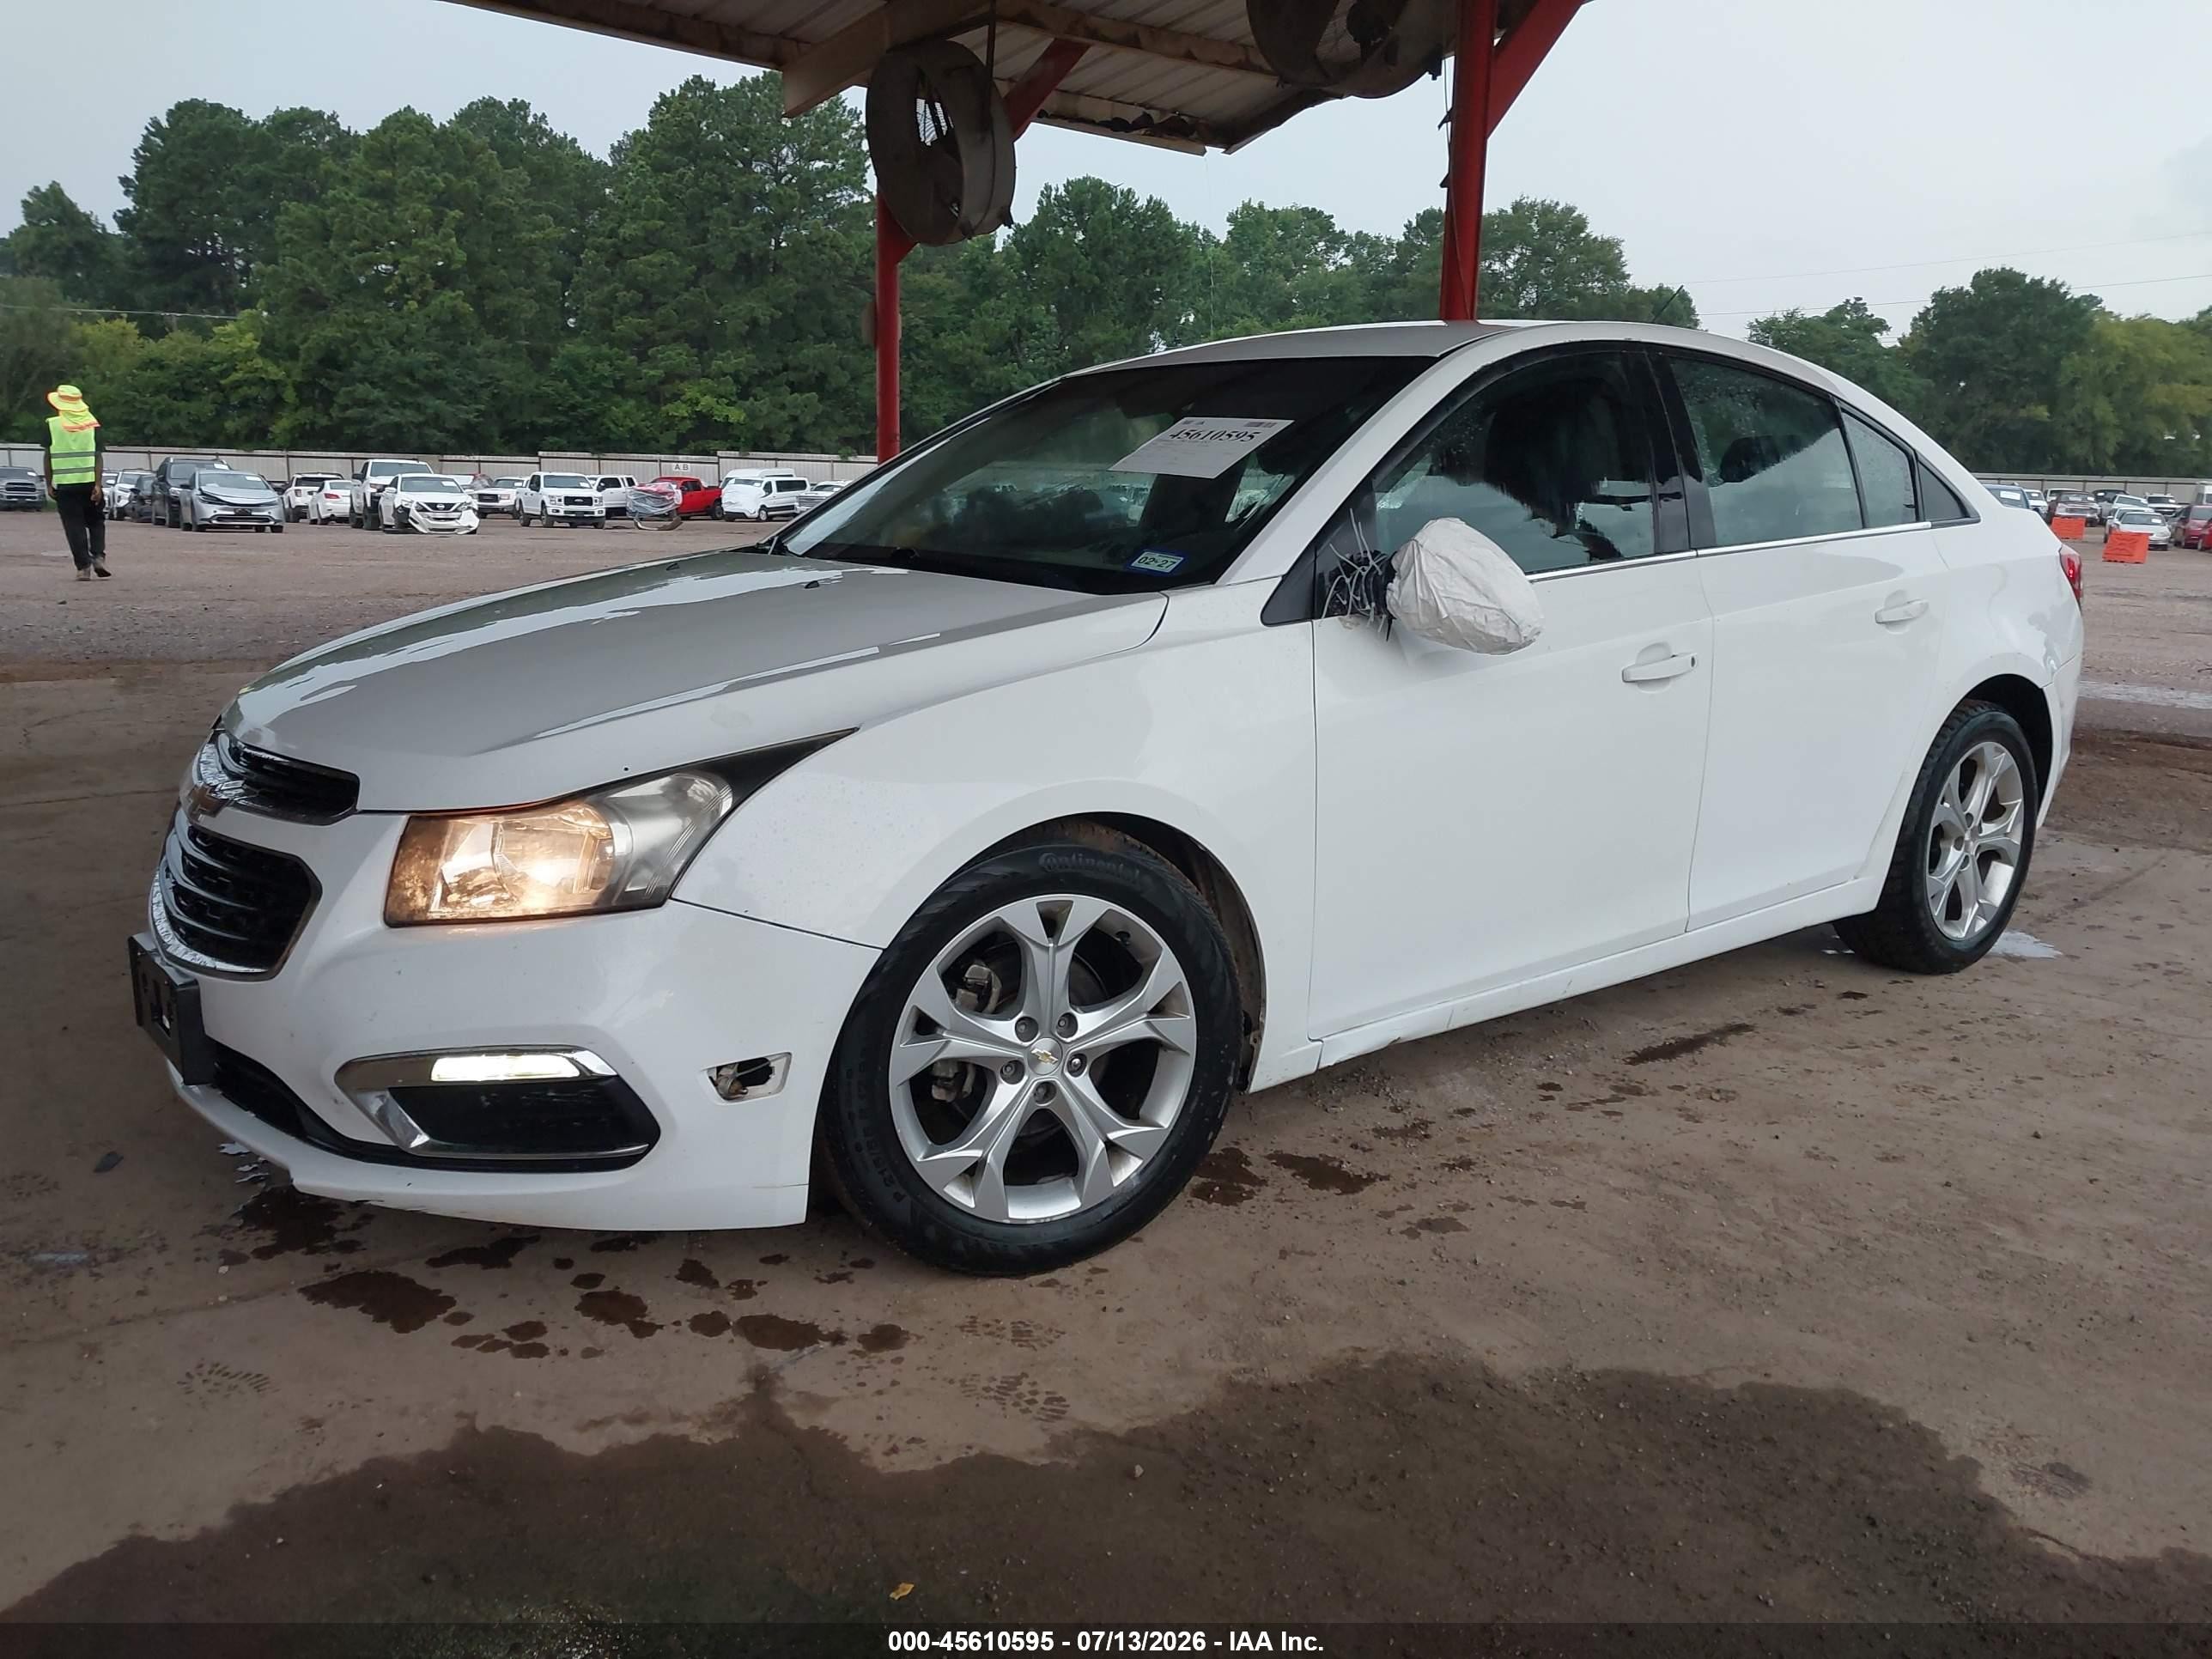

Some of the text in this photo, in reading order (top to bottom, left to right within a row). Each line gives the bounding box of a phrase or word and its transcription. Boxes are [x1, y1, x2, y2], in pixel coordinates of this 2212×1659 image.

[1170, 429, 1260, 441] 45610595
[1138, 556, 1155, 565] 02
[1157, 559, 1176, 568] 27
